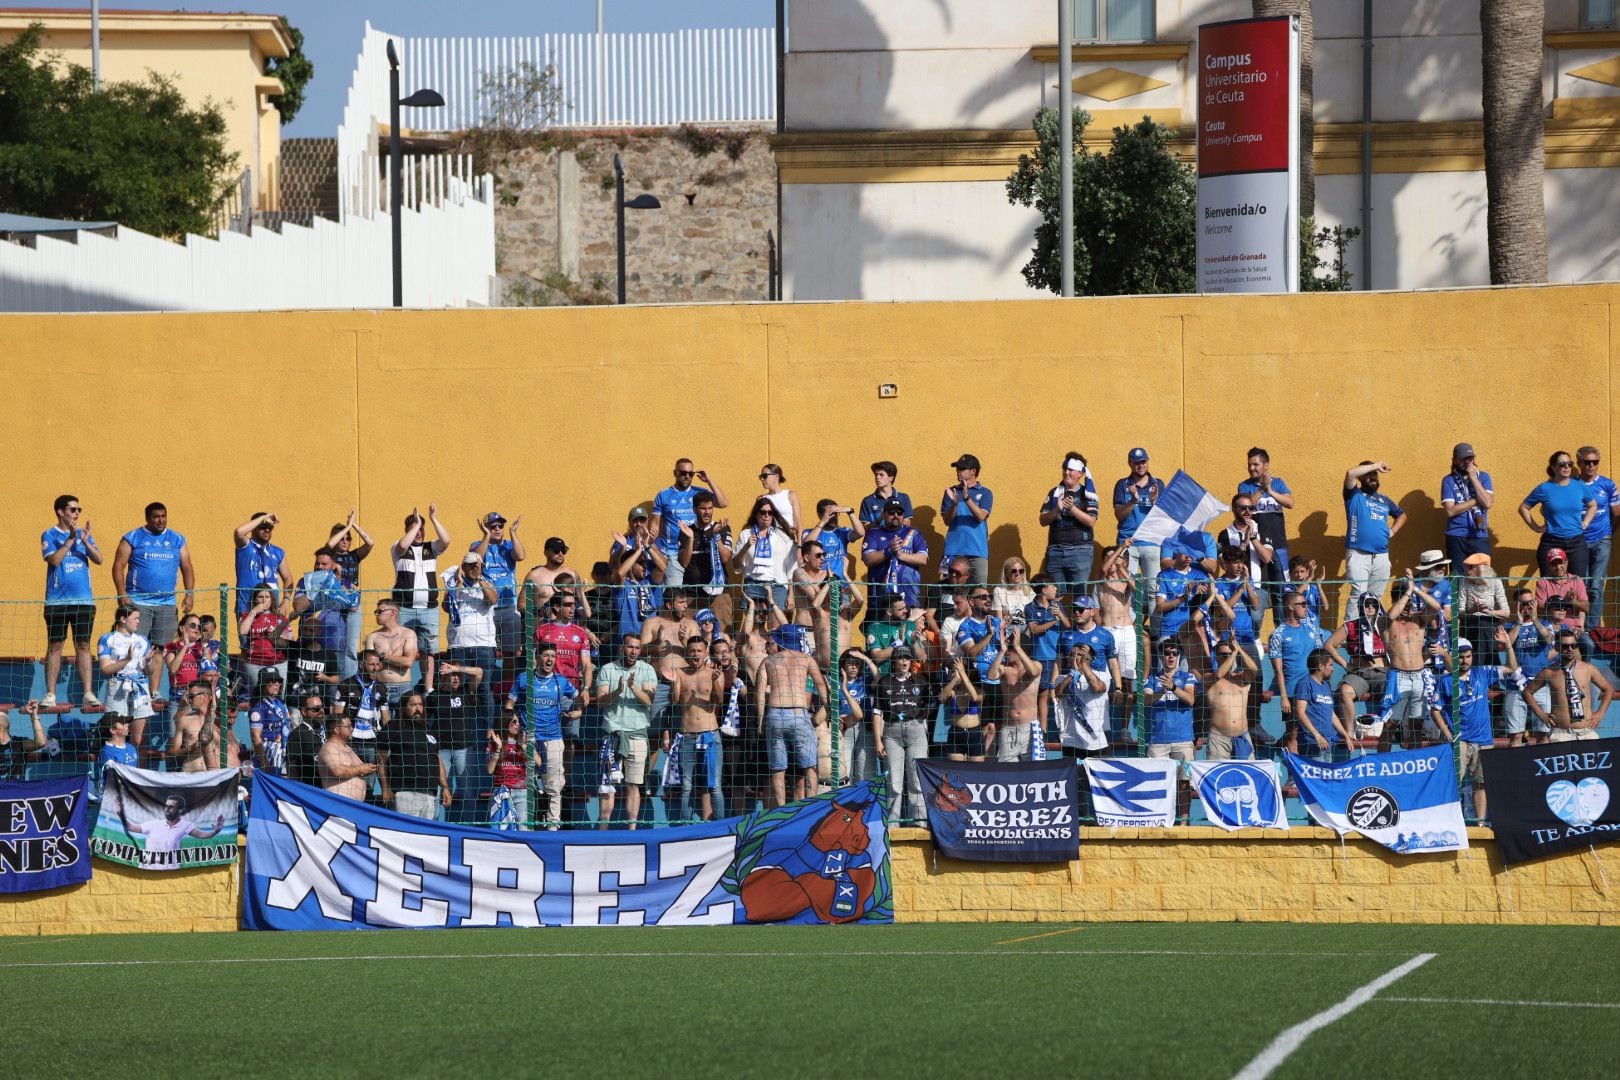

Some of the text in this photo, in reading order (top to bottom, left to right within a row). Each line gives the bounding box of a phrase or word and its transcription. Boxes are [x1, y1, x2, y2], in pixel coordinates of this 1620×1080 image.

[1205, 53, 1251, 71] Campus
[1205, 69, 1267, 88] Universitario
[1205, 90, 1245, 105] de Ceuta
[1205, 120, 1225, 132] Ceuta
[1205, 133, 1263, 146] University Campus
[1204, 203, 1267, 220] Bienvenida/o
[1205, 224, 1233, 236] Welcome
[1239, 252, 1267, 261] Granada
[1300, 756, 1439, 780] XEREZ TE ADOBO
[1534, 751, 1613, 777] XEREZ
[965, 780, 1068, 805] YOUTH
[966, 805, 1073, 828] XEREZ
[1098, 816, 1116, 826] REZ
[964, 828, 1072, 840] HOOLIGANS
[1532, 828, 1560, 844] TE
[91, 838, 239, 865] COMPETITIVIDAD
[265, 798, 737, 928] XEREZ
